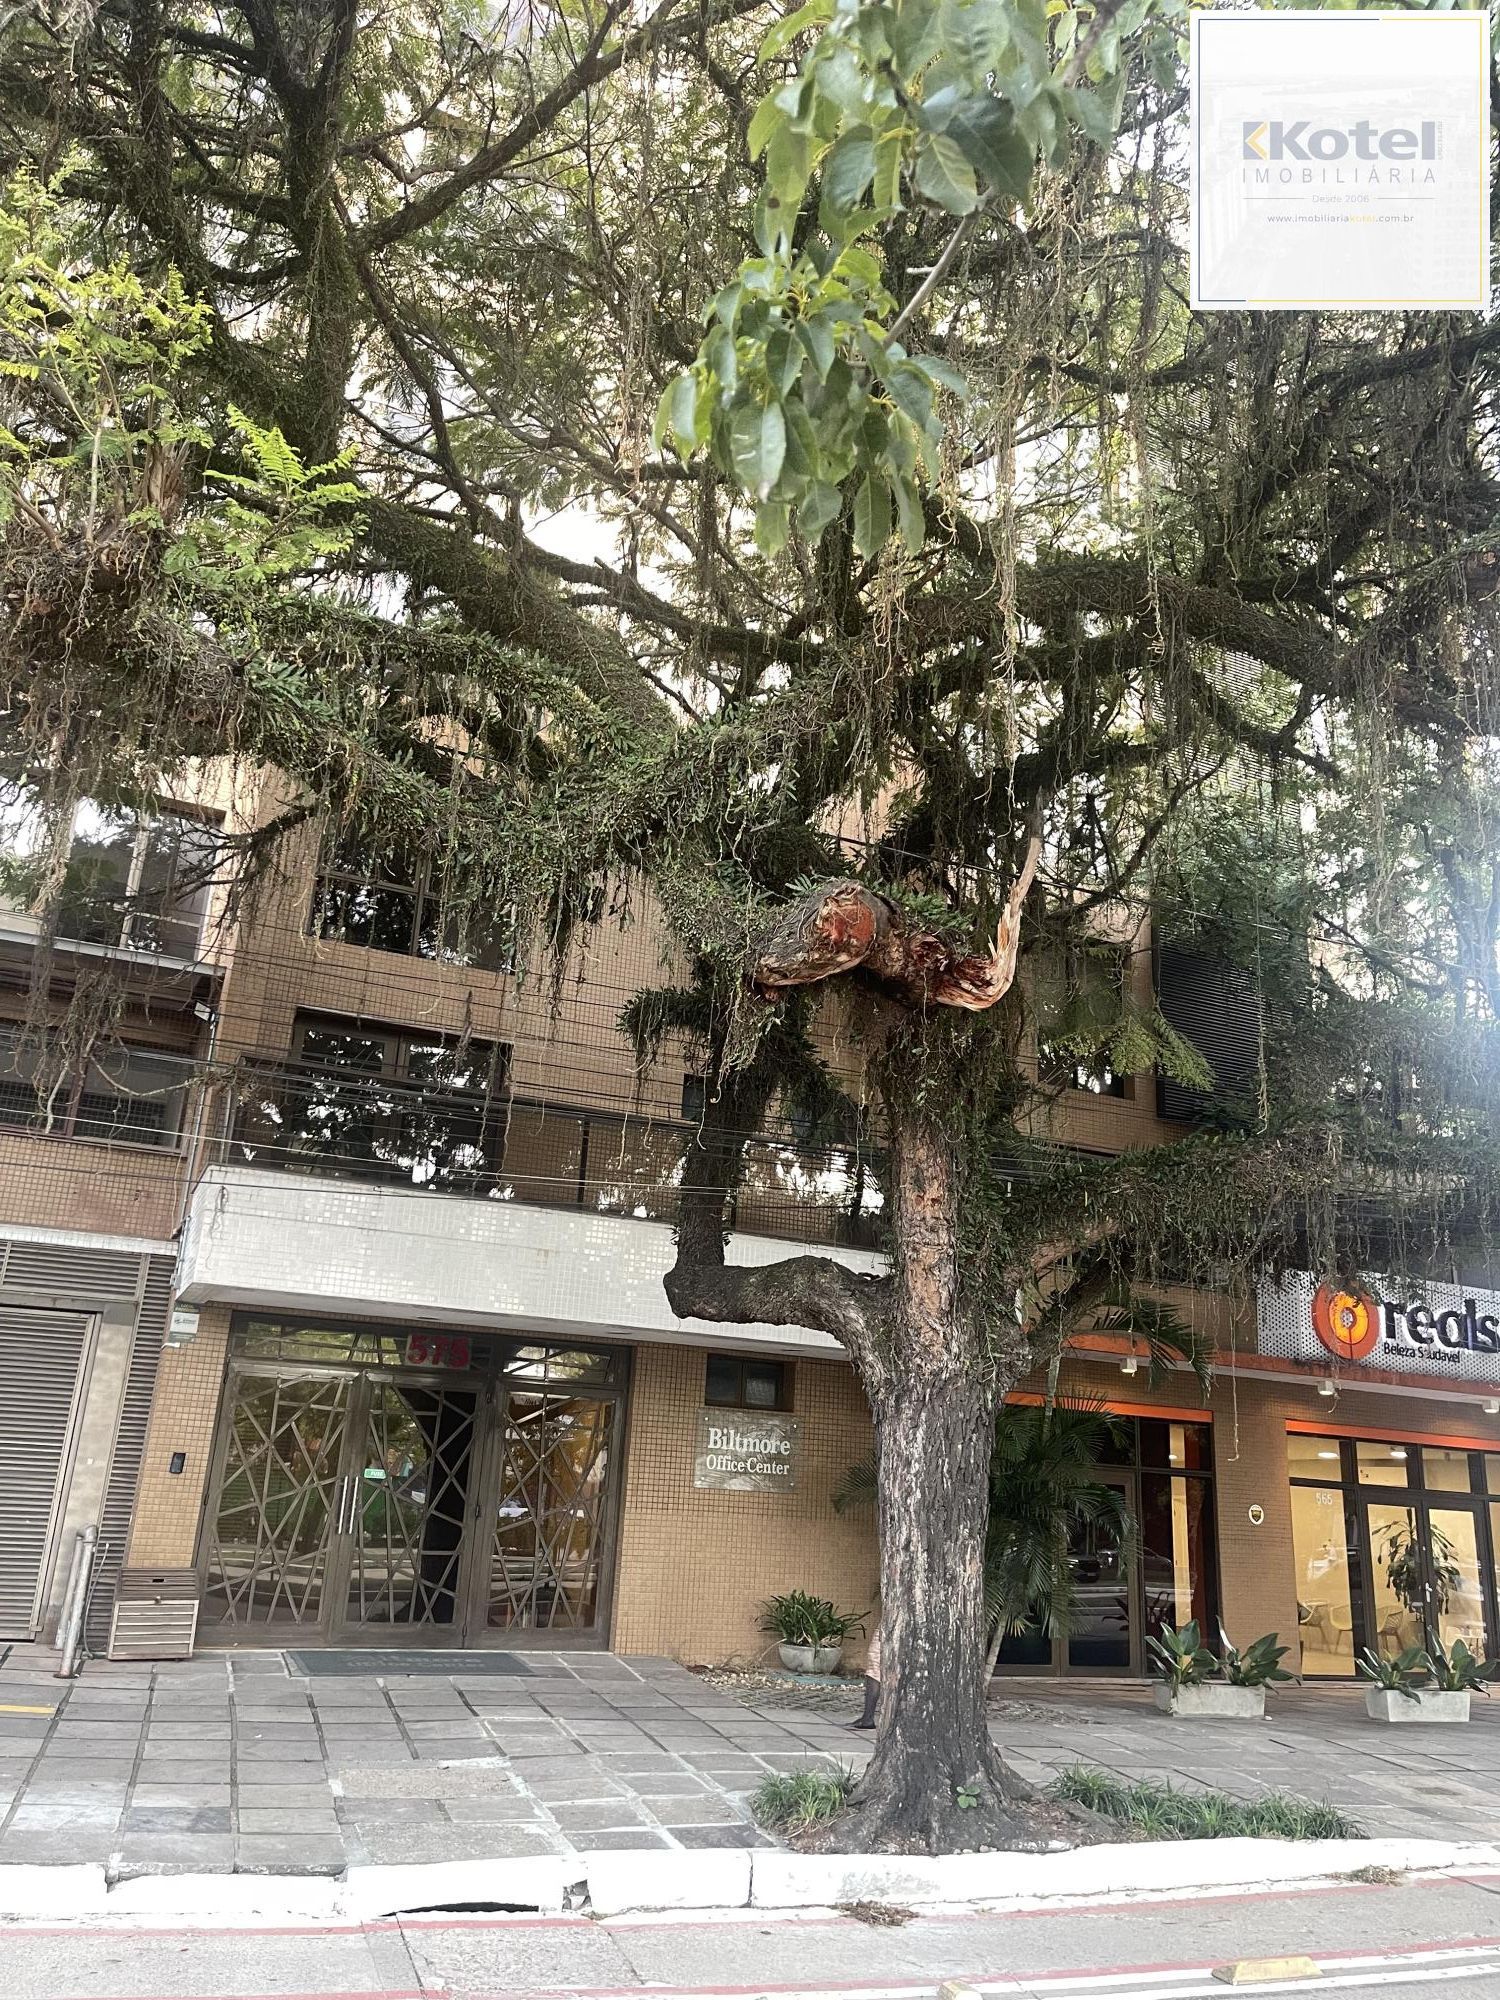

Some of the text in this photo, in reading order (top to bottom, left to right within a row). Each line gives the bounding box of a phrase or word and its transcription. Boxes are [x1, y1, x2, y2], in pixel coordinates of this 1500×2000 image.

[407, 1335, 470, 1369] 575
[1383, 1342, 1416, 1358] Beleza
[708, 1427, 791, 1456] Biltmore
[706, 1454, 790, 1475] Office Center
